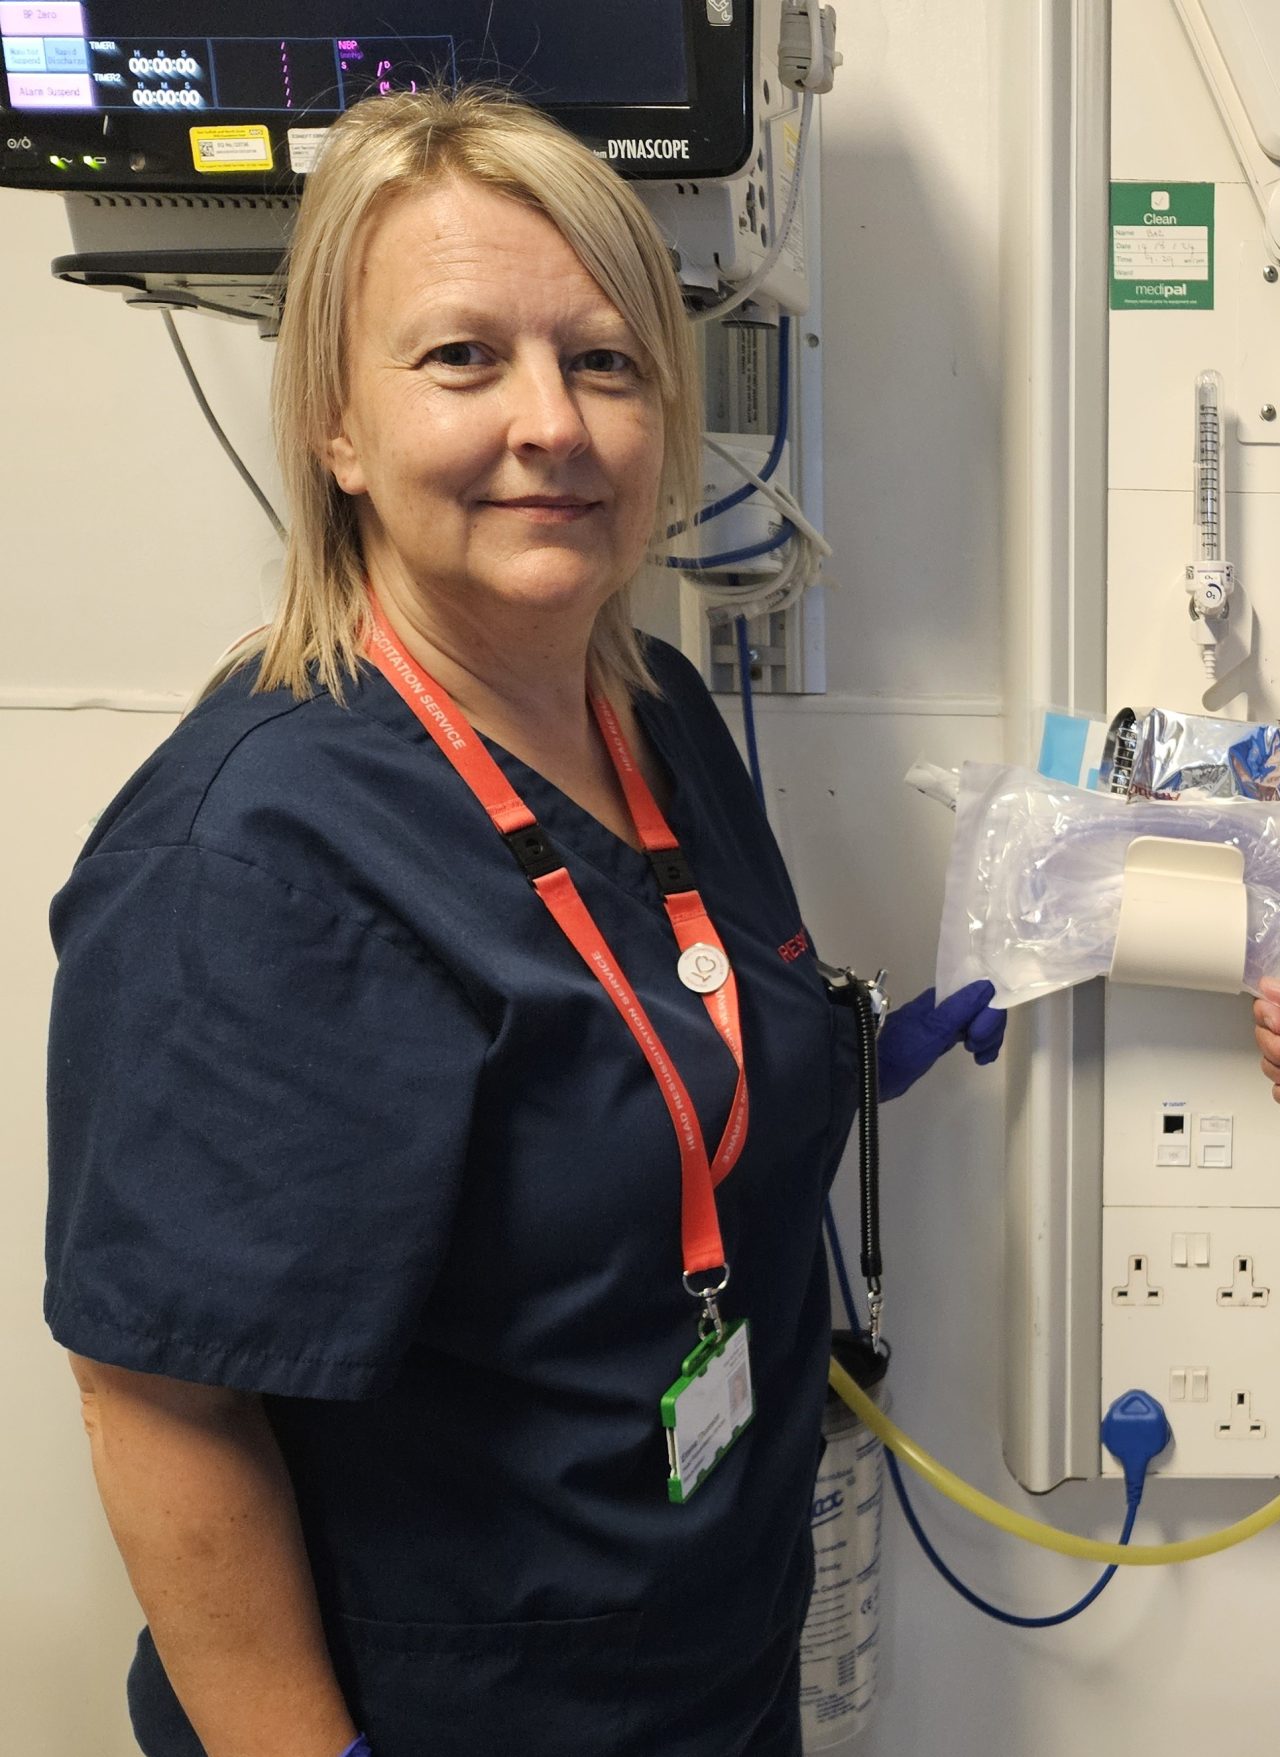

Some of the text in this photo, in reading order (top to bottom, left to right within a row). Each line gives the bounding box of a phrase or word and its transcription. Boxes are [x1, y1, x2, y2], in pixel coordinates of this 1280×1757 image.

[36, 9, 57, 19] Zero
[89, 41, 116, 50] TIMER1
[128, 57, 197, 73] 00:00:00
[93, 73, 121, 82] TIMER2
[20, 87, 80, 98] Alarm Suspend
[132, 89, 200, 106] 00:00:00
[607, 139, 690, 159] DYNASCOPE
[1143, 213, 1177, 225] Clean
[1116, 242, 1131, 250] Date
[1116, 255, 1133, 263] Time
[1135, 283, 1188, 298] medipal
[373, 627, 467, 750] SCITATION SERVICE
[591, 951, 695, 1151] HEAD RESUSCITATION SERVICE
